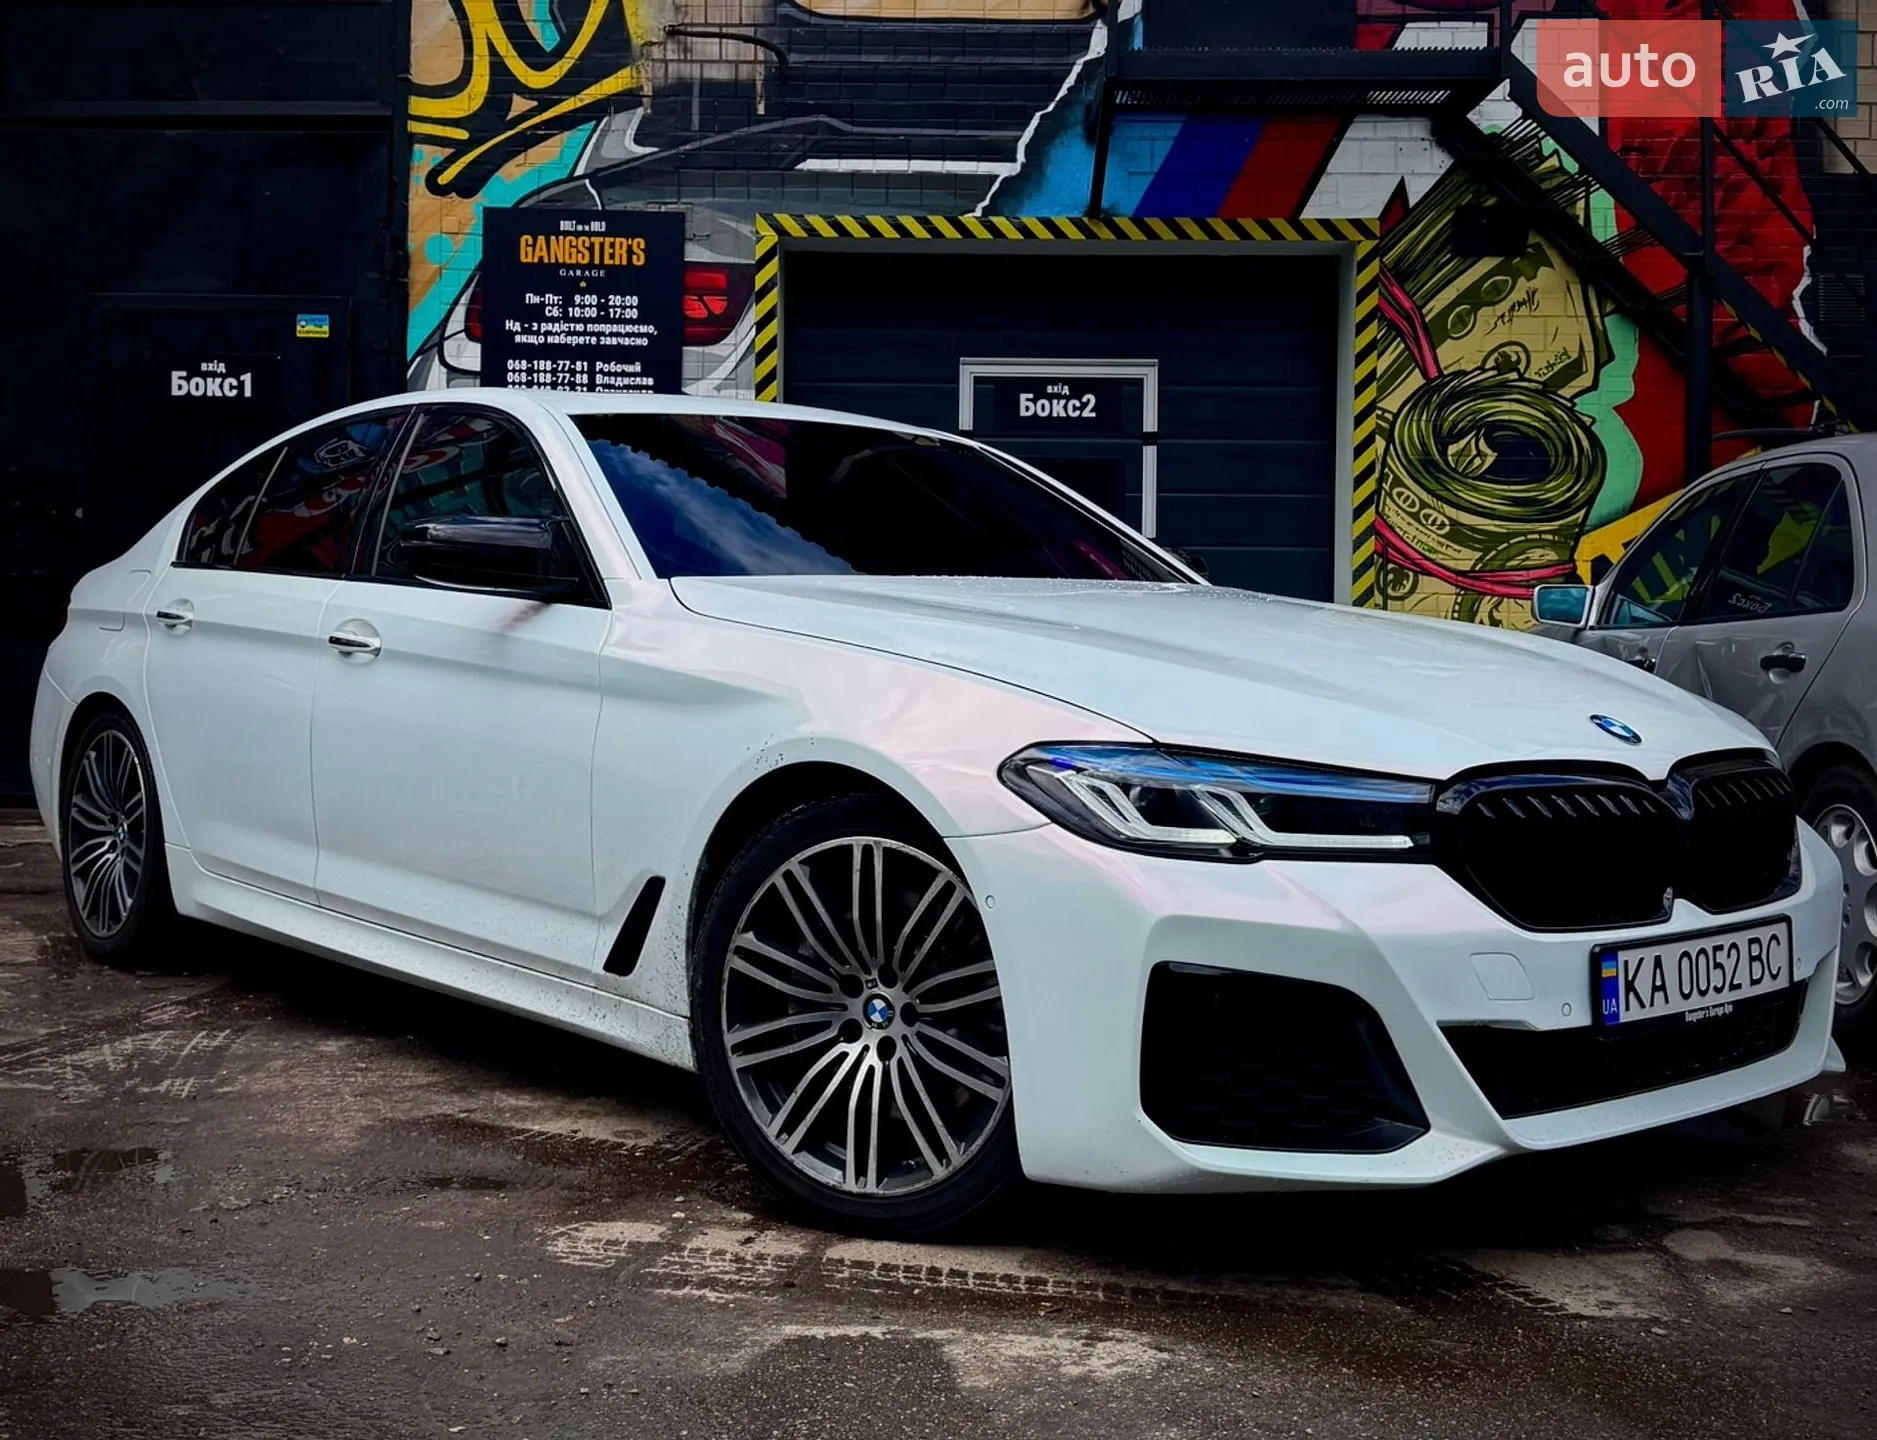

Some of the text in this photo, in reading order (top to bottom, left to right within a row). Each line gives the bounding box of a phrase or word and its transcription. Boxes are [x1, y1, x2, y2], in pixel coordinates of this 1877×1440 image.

[519, 234, 646, 266] GANGSTER'S
[559, 269, 606, 278] GARAGE
[525, 293, 563, 305] Пн-Пт:
[574, 295, 598, 306] 9:00
[608, 295, 638, 306] 20:00
[545, 306, 563, 317] Сб:
[568, 307, 598, 318] 10:00
[609, 307, 638, 319] 17:00
[505, 319, 521, 333] Нд
[532, 322, 538, 331] з
[540, 321, 585, 334] радістю
[514, 333, 649, 346] якщо наберете завчасно
[201, 360, 226, 374] вхід
[507, 359, 641, 373] 068-188-77-81 Робочий
[171, 370, 252, 397] Бокс1
[507, 372, 654, 387] 068-188-77-88 Владислав
[1046, 382, 1070, 395] вхід
[1019, 393, 1097, 418] Бокс2
[1623, 933, 1782, 1012] KA 0052 BC
[1602, 998, 1618, 1015] UA
